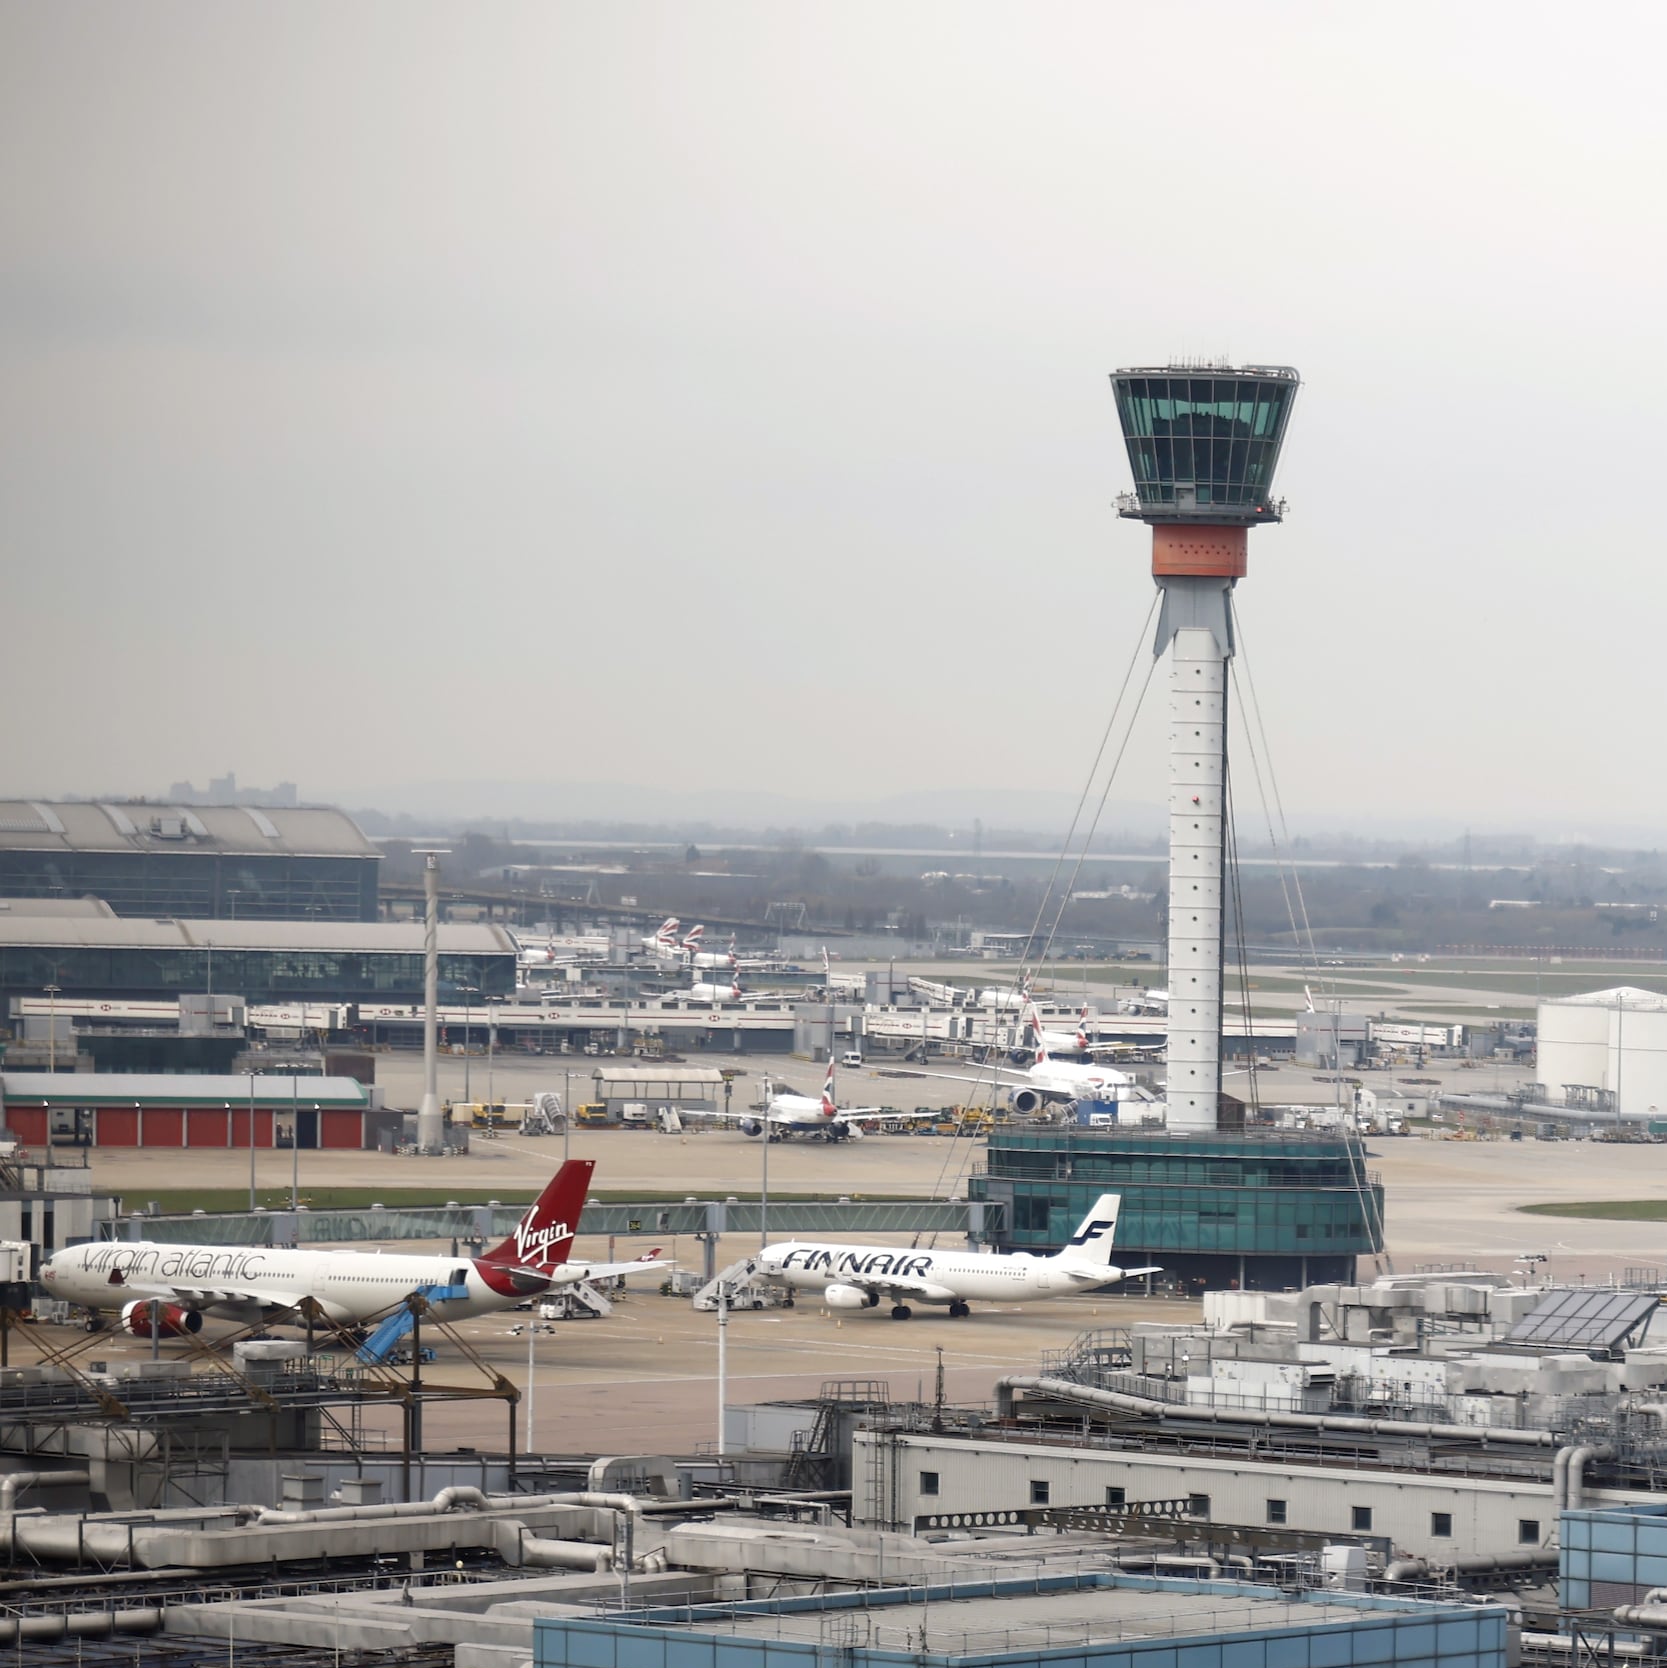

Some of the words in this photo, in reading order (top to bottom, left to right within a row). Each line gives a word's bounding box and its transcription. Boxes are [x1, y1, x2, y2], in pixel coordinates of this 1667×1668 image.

[514, 1206, 574, 1268] Virgin
[160, 1248, 266, 1281] atlantic
[783, 1248, 933, 1278] FINNAIR
